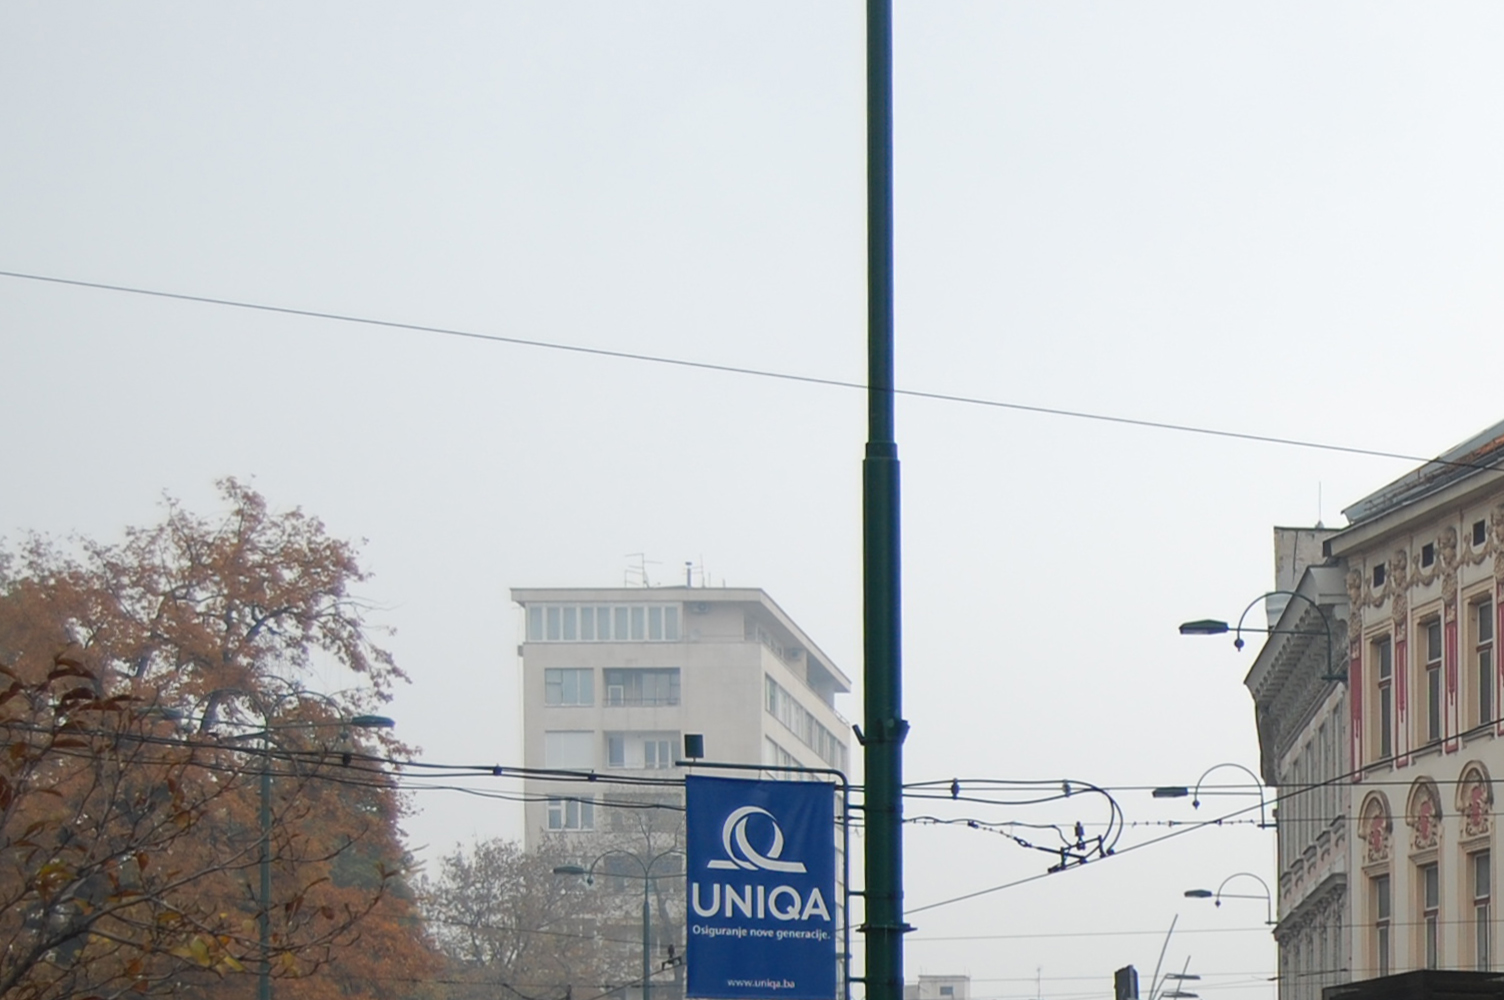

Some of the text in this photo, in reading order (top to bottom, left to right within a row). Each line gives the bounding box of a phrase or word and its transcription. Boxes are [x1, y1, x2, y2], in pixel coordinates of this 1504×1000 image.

[692, 882, 831, 921] UNIQA
[692, 924, 832, 941] Osiguranje nove generacije.
[727, 979, 796, 989] www.uniqa.ba
